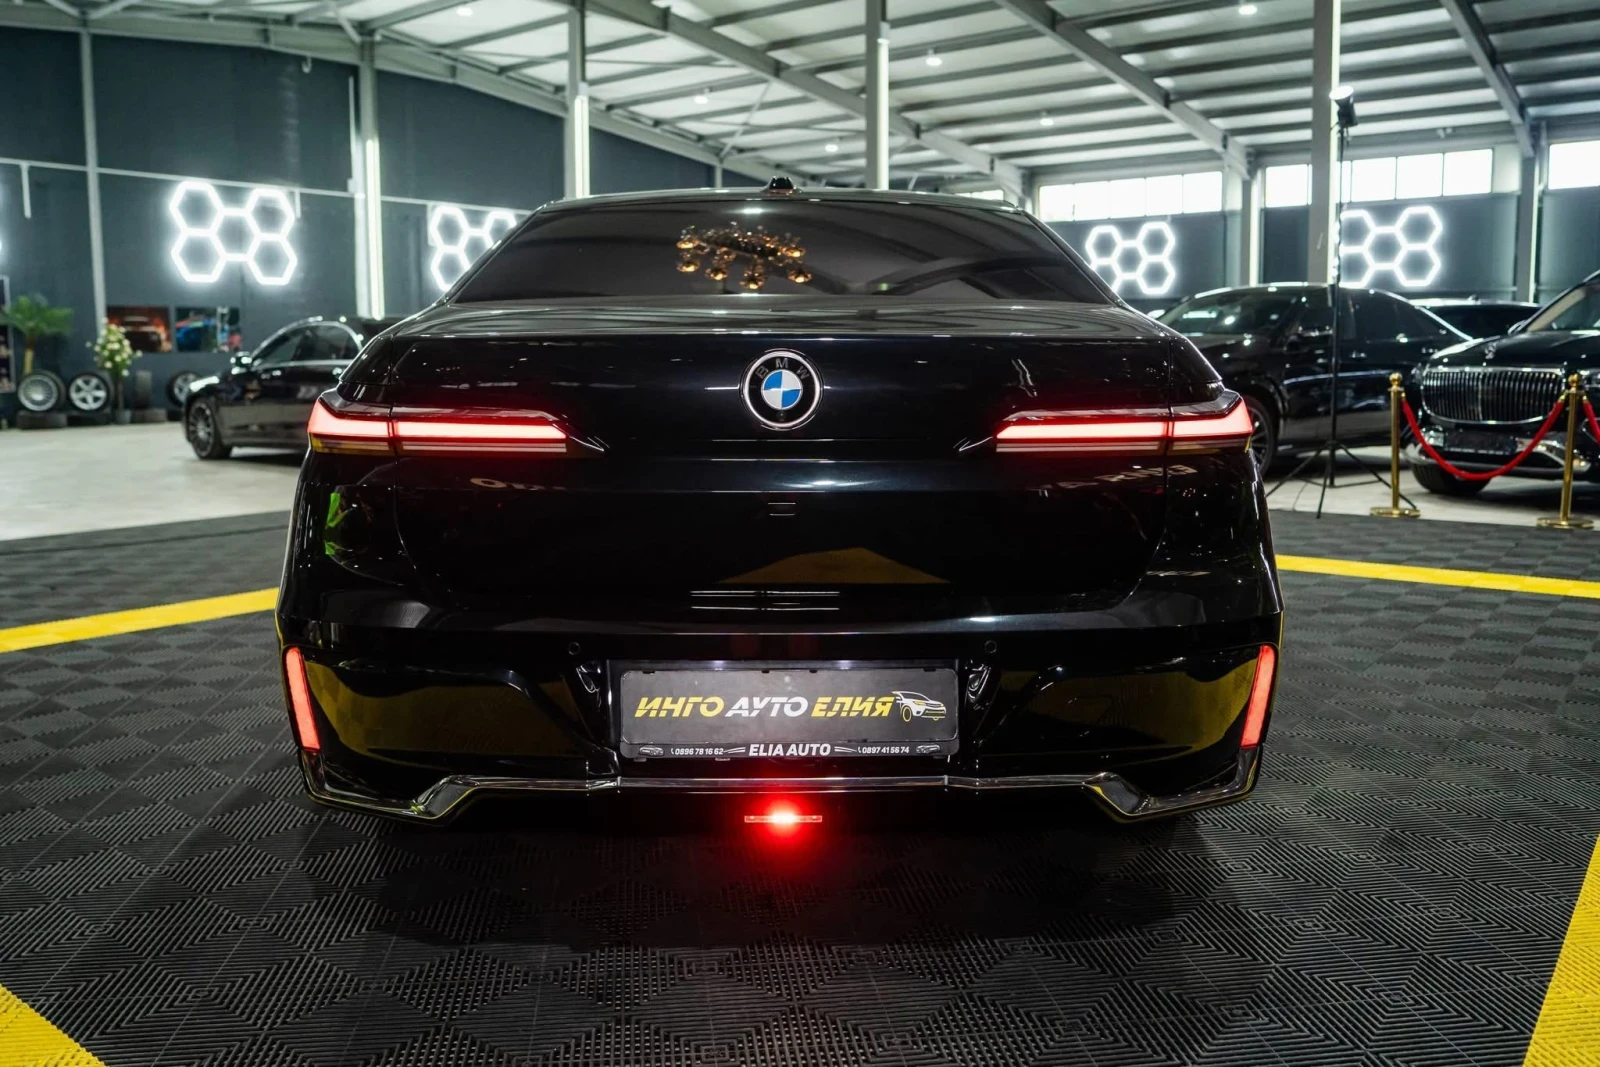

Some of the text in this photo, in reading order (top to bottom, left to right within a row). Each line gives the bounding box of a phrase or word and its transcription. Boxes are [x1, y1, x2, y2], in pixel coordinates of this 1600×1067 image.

[755, 358, 810, 380] BMW
[634, 696, 895, 718] ИНГО АУТО ЕЛИЯ
[748, 743, 831, 757] ELIA AUTO
